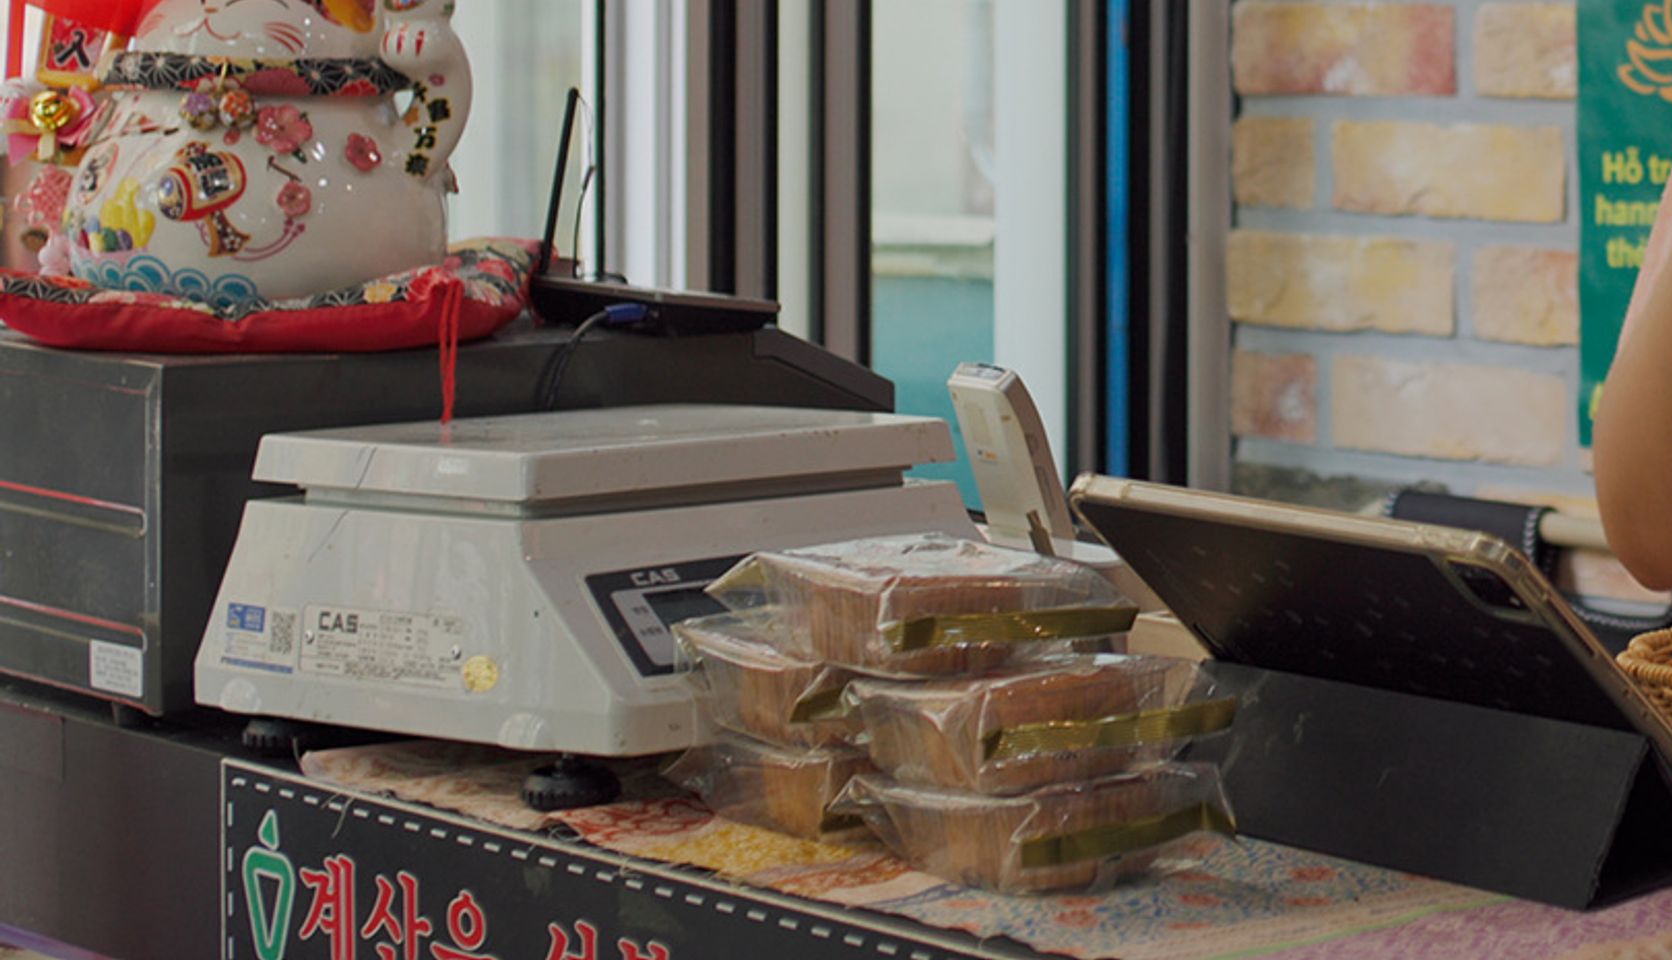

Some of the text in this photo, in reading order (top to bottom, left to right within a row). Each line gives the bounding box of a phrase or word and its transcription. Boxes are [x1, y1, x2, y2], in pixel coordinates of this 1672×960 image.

[1602, 146, 1644, 185] Hỗ
[629, 567, 681, 587] CAS
[318, 610, 360, 634] CAS
